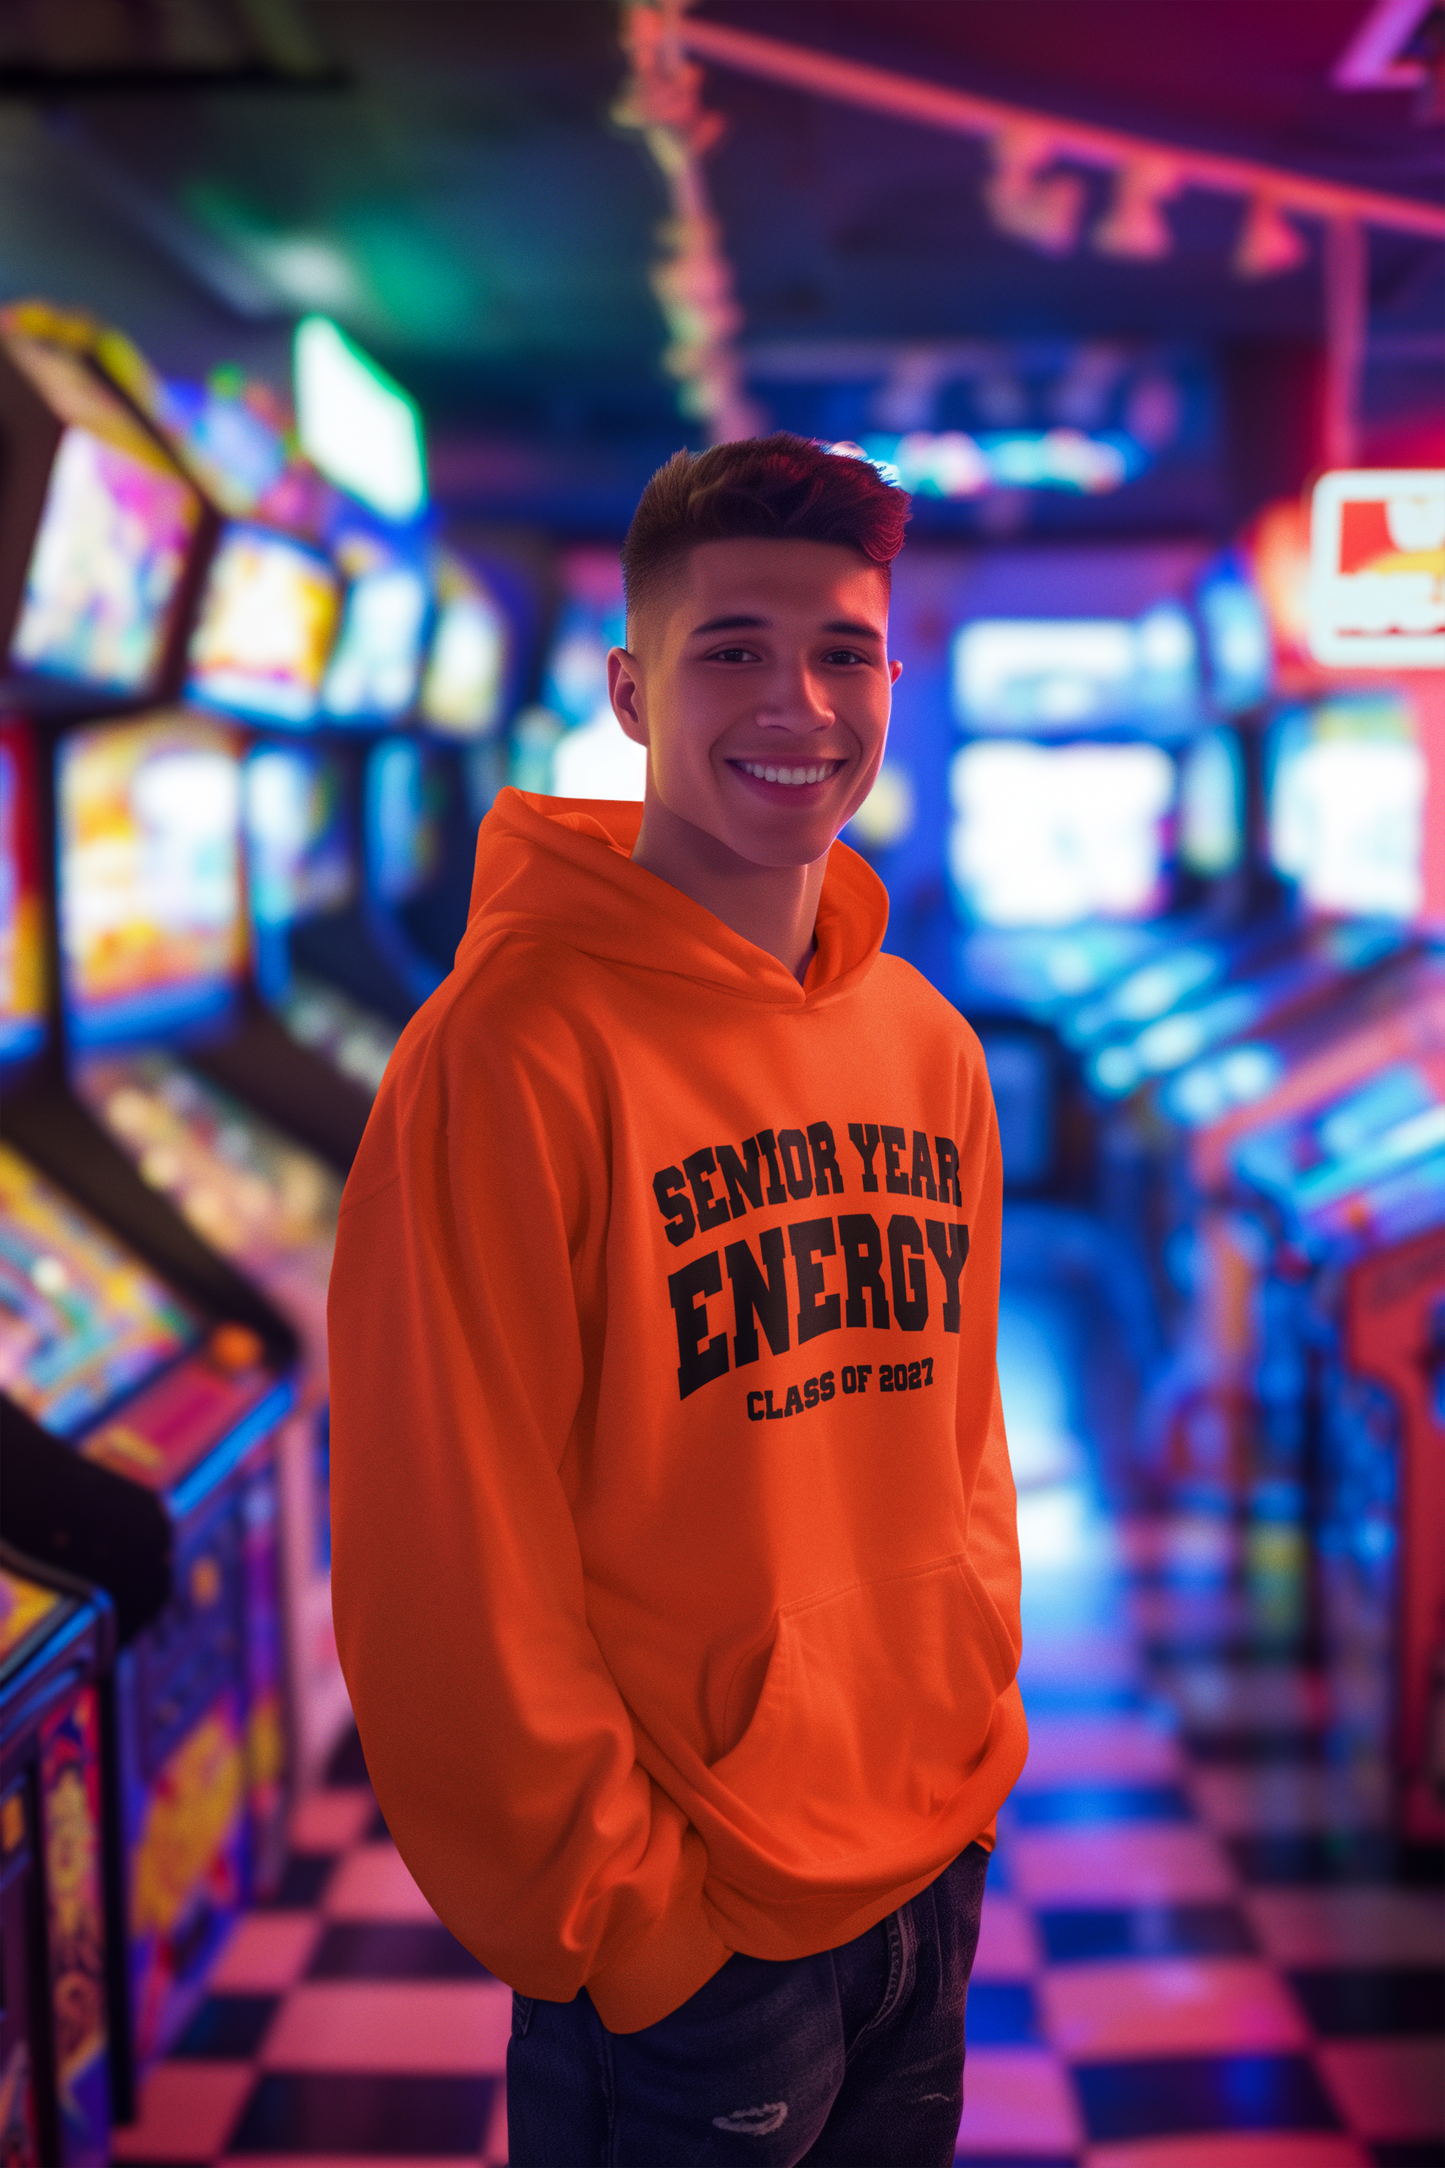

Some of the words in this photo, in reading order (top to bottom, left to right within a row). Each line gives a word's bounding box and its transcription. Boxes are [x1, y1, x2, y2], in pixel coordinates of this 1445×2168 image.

[652, 1121, 844, 1247] SENIOR
[848, 1123, 962, 1208] YEAR
[668, 1214, 970, 1401] ENERGY
[747, 1371, 835, 1421] CLASS
[842, 1365, 872, 1394] OF
[879, 1357, 934, 1392] 2027
